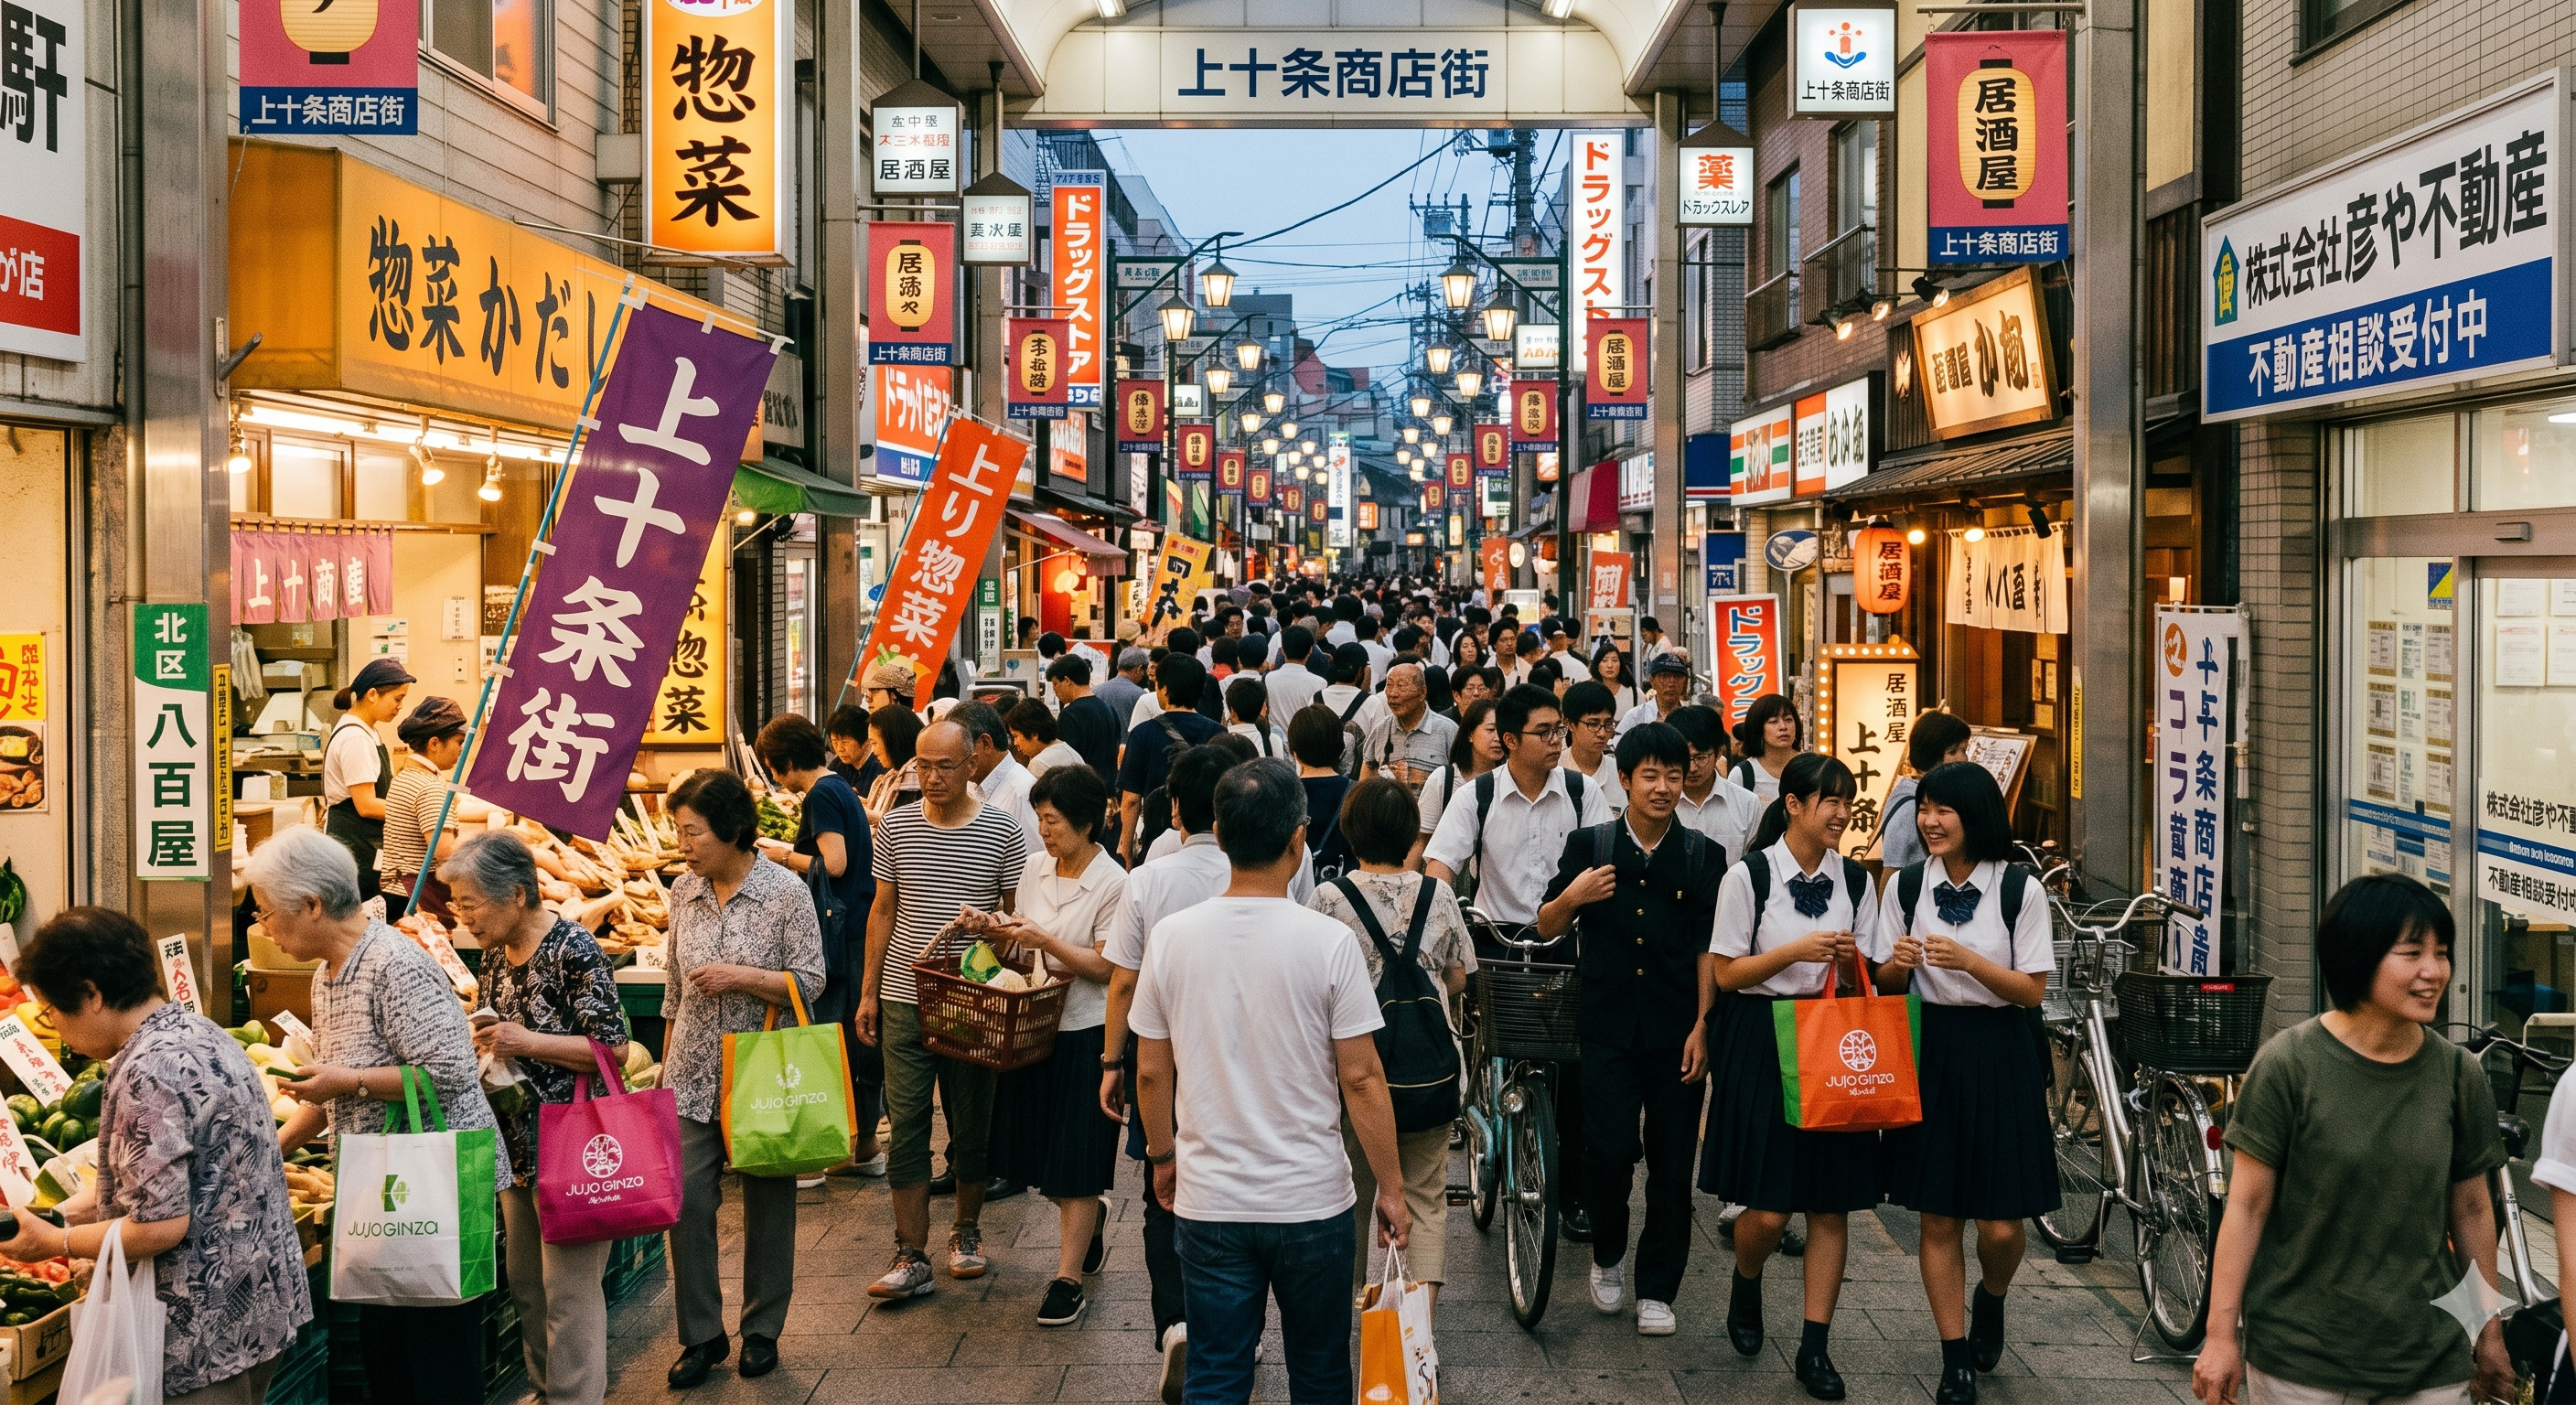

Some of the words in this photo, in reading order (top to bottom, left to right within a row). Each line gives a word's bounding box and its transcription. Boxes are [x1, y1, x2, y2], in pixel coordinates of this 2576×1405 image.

[1177, 48, 1489, 99] 上十条商店街
[1802, 80, 1890, 102] 上十条商店街
[252, 95, 404, 125] 上十条商店街
[671, 34, 760, 229] 惣菜
[1975, 78, 2018, 190] 居酒屋
[879, 159, 950, 180] 居酒屋
[1698, 155, 1733, 189] 薬
[1940, 231, 2058, 255] 上十条商店街
[2246, 130, 2548, 309] 株式会社彦や不動産
[2249, 288, 2486, 397] 不動産相談受付中
[508, 357, 719, 802] 上十条街
[890, 444, 1000, 648] 上り惣菜
[155, 612, 188, 681] 北区
[1884, 672, 1906, 744] 居酒屋
[146, 702, 198, 867] 八百屋
